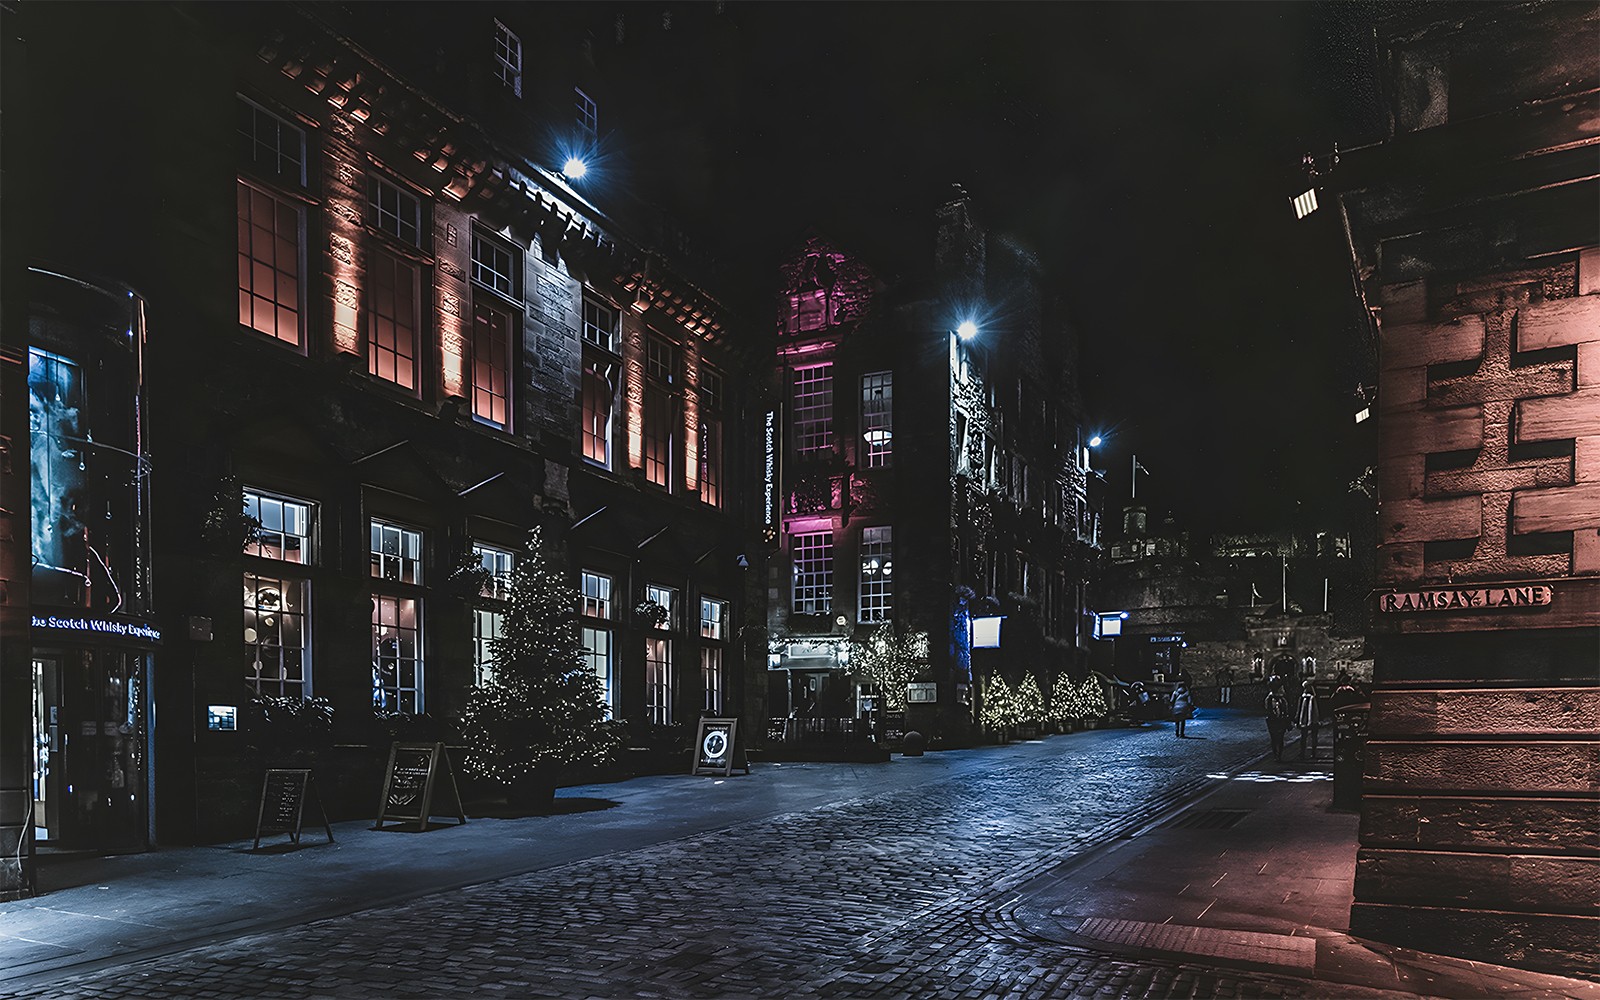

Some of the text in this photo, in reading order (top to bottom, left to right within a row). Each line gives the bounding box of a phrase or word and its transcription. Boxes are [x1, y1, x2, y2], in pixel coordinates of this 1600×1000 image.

[764, 411, 774, 524] The Scotch Whisky Experience
[1386, 587, 1544, 610] RAMSAY LANE
[48, 615, 88, 630] Scotch
[90, 619, 127, 635] Whisky
